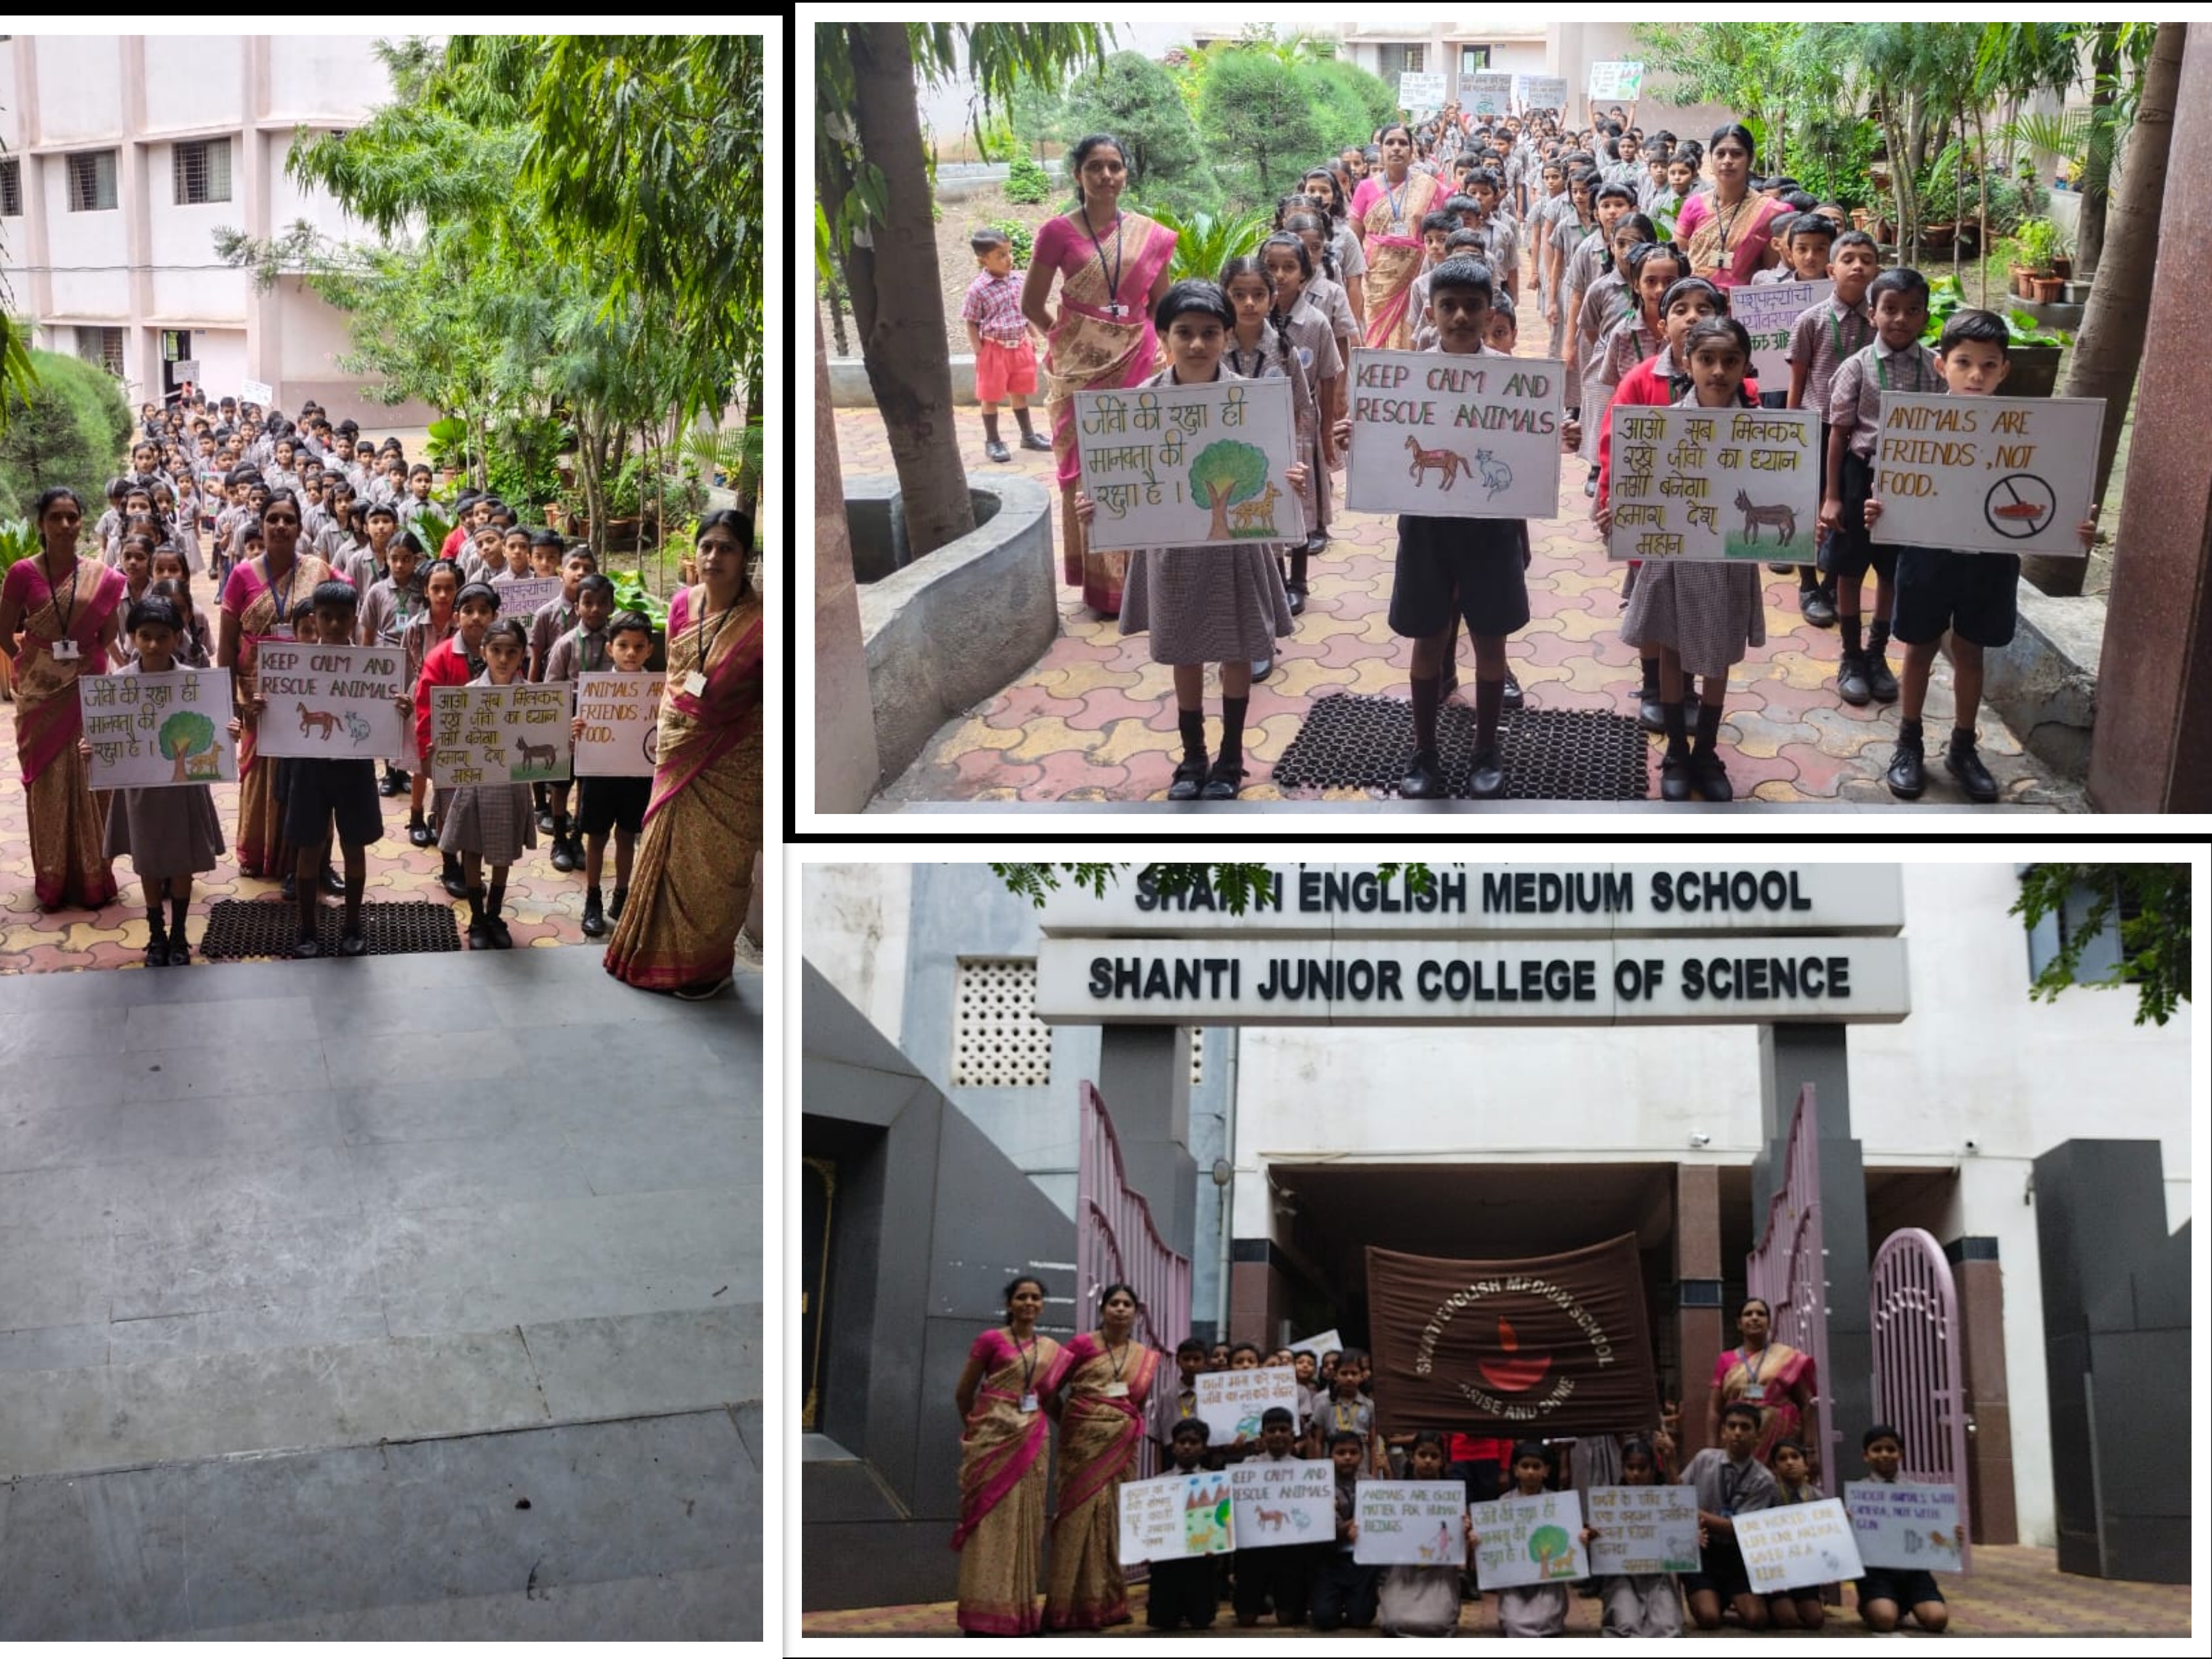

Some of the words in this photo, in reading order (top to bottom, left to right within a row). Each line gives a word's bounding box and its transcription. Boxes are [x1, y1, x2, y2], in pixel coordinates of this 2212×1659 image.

[1357, 363, 1410, 389] KEEP
[1427, 367, 1488, 394] CALM
[1502, 372, 1550, 398] AND
[1134, 392, 1162, 431] की
[1219, 387, 1249, 426] ही
[1355, 397, 1437, 425] RESCUE
[1454, 404, 1555, 434] ANIMALS
[1886, 406, 1977, 432] ANIMALS
[1991, 411, 2034, 435] ARE
[1618, 410, 1667, 440] आओ
[1684, 419, 1714, 441] सब
[1731, 414, 1809, 447] मिलकर
[1160, 429, 1187, 467] की
[1717, 447, 1742, 470] का
[1750, 449, 1798, 472] ध्यान
[1881, 439, 1978, 466] FRIENDS
[1142, 469, 1165, 505] है
[1659, 470, 1709, 498] बनेगा
[1880, 471, 1938, 497] FOOD.
[1686, 499, 1718, 535] देश
[1636, 533, 1684, 558] महान
[262, 652, 299, 670] KEEP
[310, 655, 351, 673] CALM
[363, 658, 395, 675] AND
[119, 676, 141, 703] की
[180, 674, 200, 701] ही
[262, 676, 317, 695] RESCUE
[330, 679, 399, 700] ANIMALS
[435, 688, 468, 709] आओ
[481, 691, 502, 709] सब
[513, 687, 564, 707] मिलकर
[583, 681, 638, 697] ANIMALS
[646, 681, 665, 697] AR
[138, 702, 156, 730] की
[504, 711, 520, 724] का
[526, 709, 558, 724] ध्यान
[581, 704, 639, 721] FRIENDS
[451, 768, 482, 784] महान
[1300, 872, 1465, 913] ENGLISH
[1483, 872, 1633, 914] MEDIUM
[1651, 870, 1812, 912] SCHOOL
[1089, 957, 1240, 1000] SHANTI
[1258, 958, 1403, 1001] JUNIOR
[1417, 959, 1595, 1001] COLLEGE
[1614, 959, 1664, 1001] OF
[1681, 957, 1850, 1001] SCIENCE
[1569, 1305, 1614, 1367] SCHOOL
[1264, 1468, 1294, 1481] CALM
[1303, 1467, 1327, 1480] AND
[1279, 1485, 1331, 1499] ANIMALS
